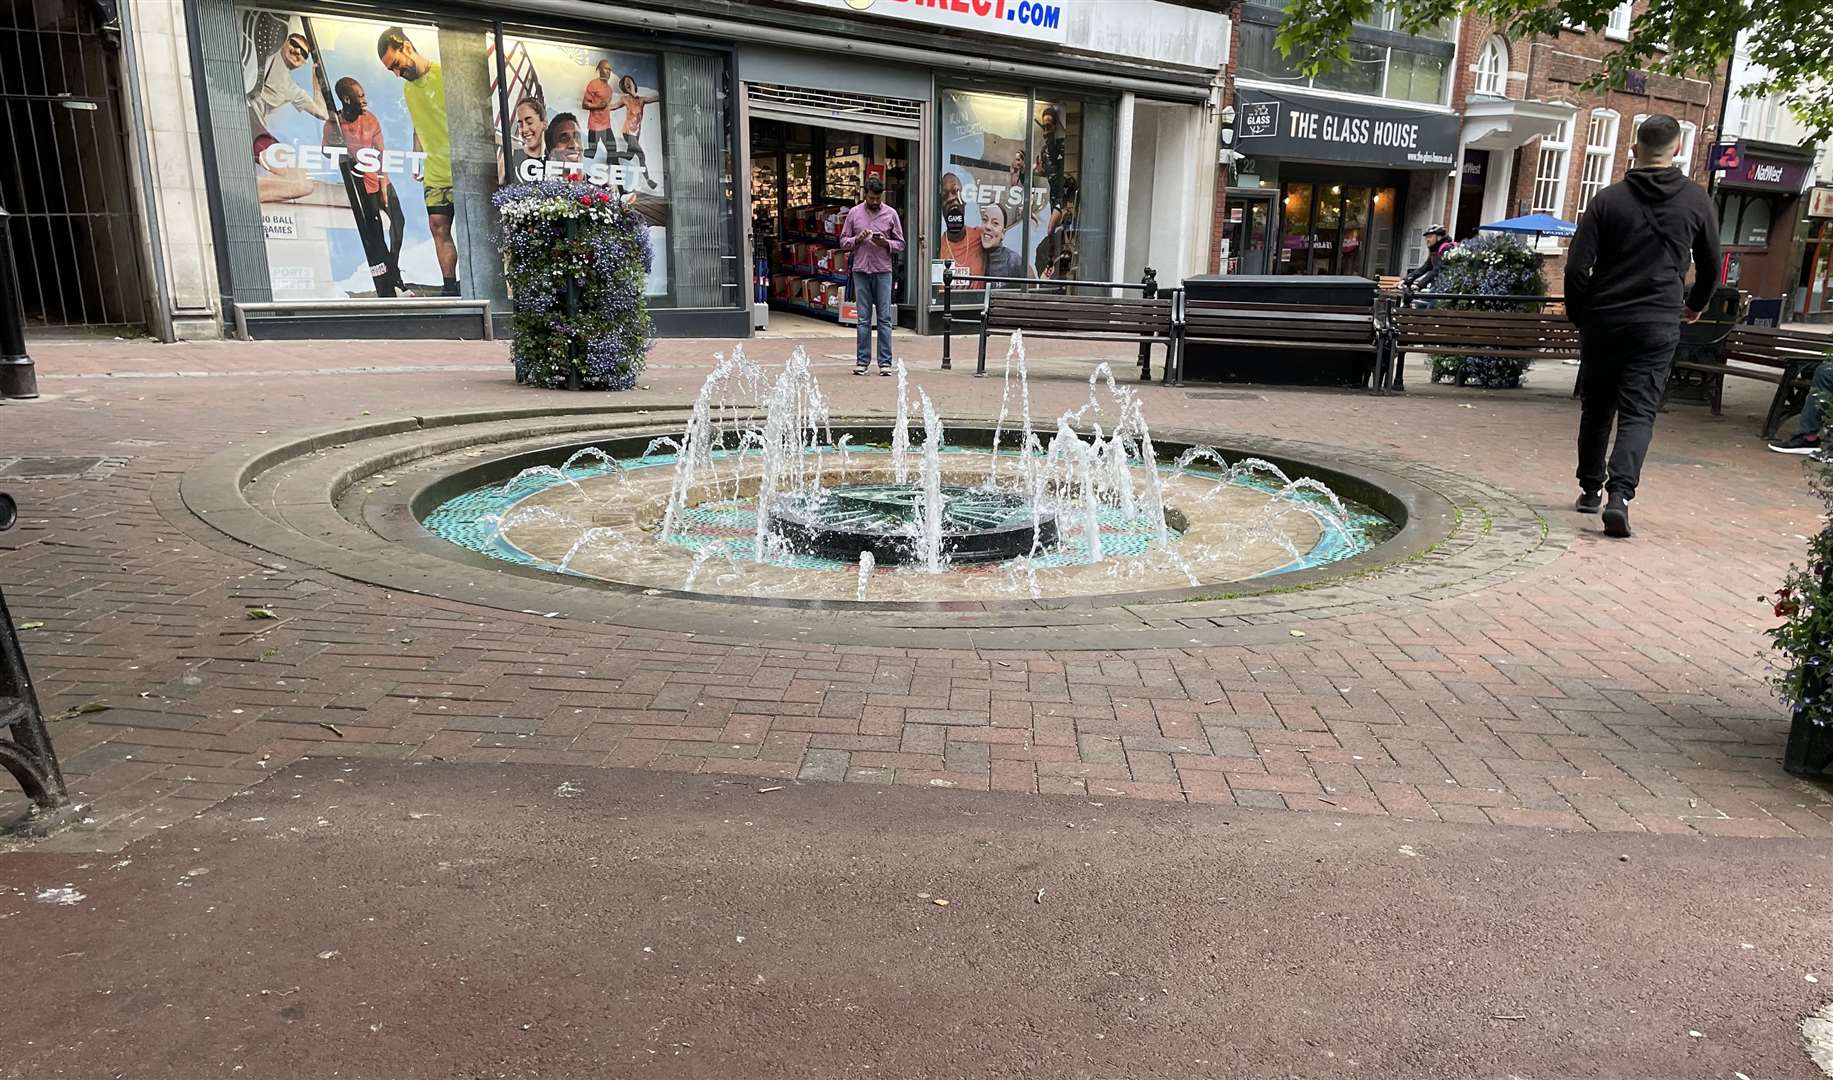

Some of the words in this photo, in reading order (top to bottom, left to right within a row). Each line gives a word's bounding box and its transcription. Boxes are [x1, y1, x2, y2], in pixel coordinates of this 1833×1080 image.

[891, 0, 1061, 29] ECT.COM
[1247, 115, 1271, 125] GLASS
[1289, 111, 1319, 139] THE
[1322, 115, 1370, 144] GLASS
[1373, 121, 1419, 148] HOUSE
[264, 143, 347, 170] GET
[354, 148, 428, 174] SET
[1243, 159, 1256, 173] 22
[520, 158, 584, 182] GET
[588, 164, 646, 191] SET
[1754, 164, 1783, 182] NatWest
[963, 183, 1006, 204] GET
[1008, 186, 1048, 206] ST
[273, 216, 295, 225] BALL
